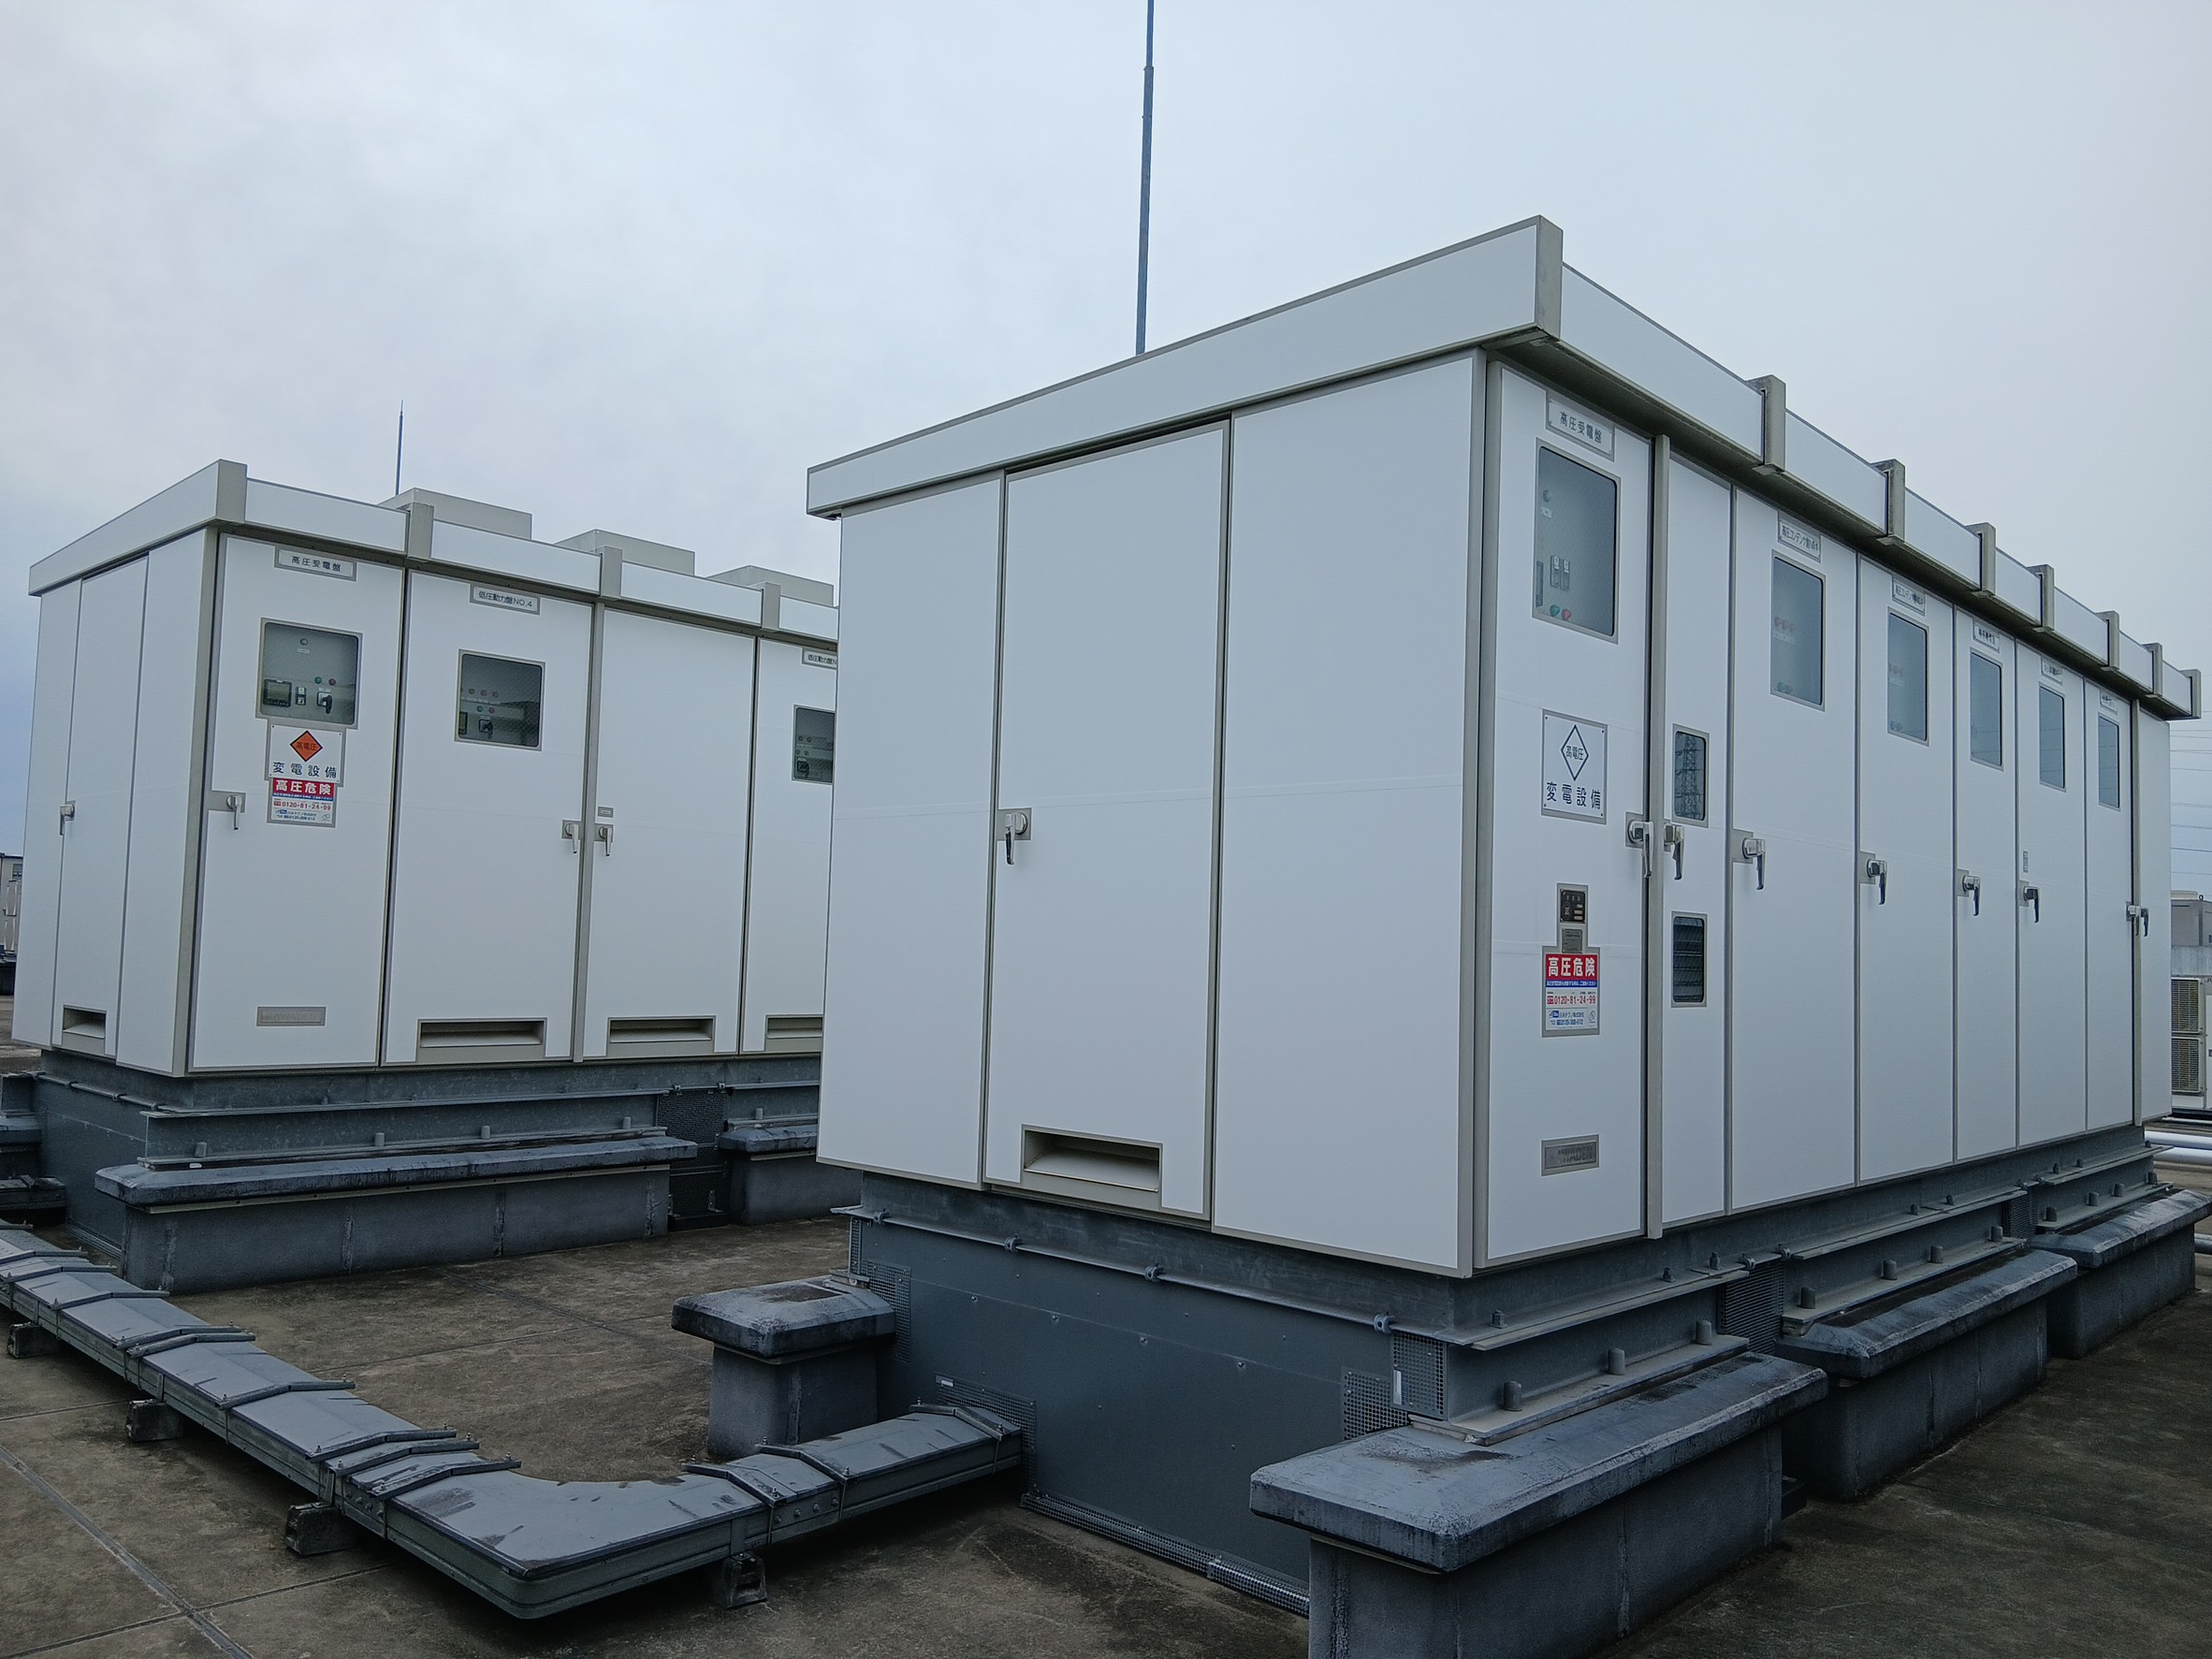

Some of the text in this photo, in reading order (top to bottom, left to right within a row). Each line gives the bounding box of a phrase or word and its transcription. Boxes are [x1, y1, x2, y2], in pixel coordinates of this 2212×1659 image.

[1560, 412, 1602, 444] 高圧受電盤
[291, 556, 341, 572] 高圧受電盤
[1565, 745, 1584, 761] 高電圧
[273, 762, 337, 779] 変電設備
[275, 779, 331, 795] 高圧危険
[1546, 781, 1601, 810] 変電設備
[1548, 956, 1595, 977] 高圧危険
